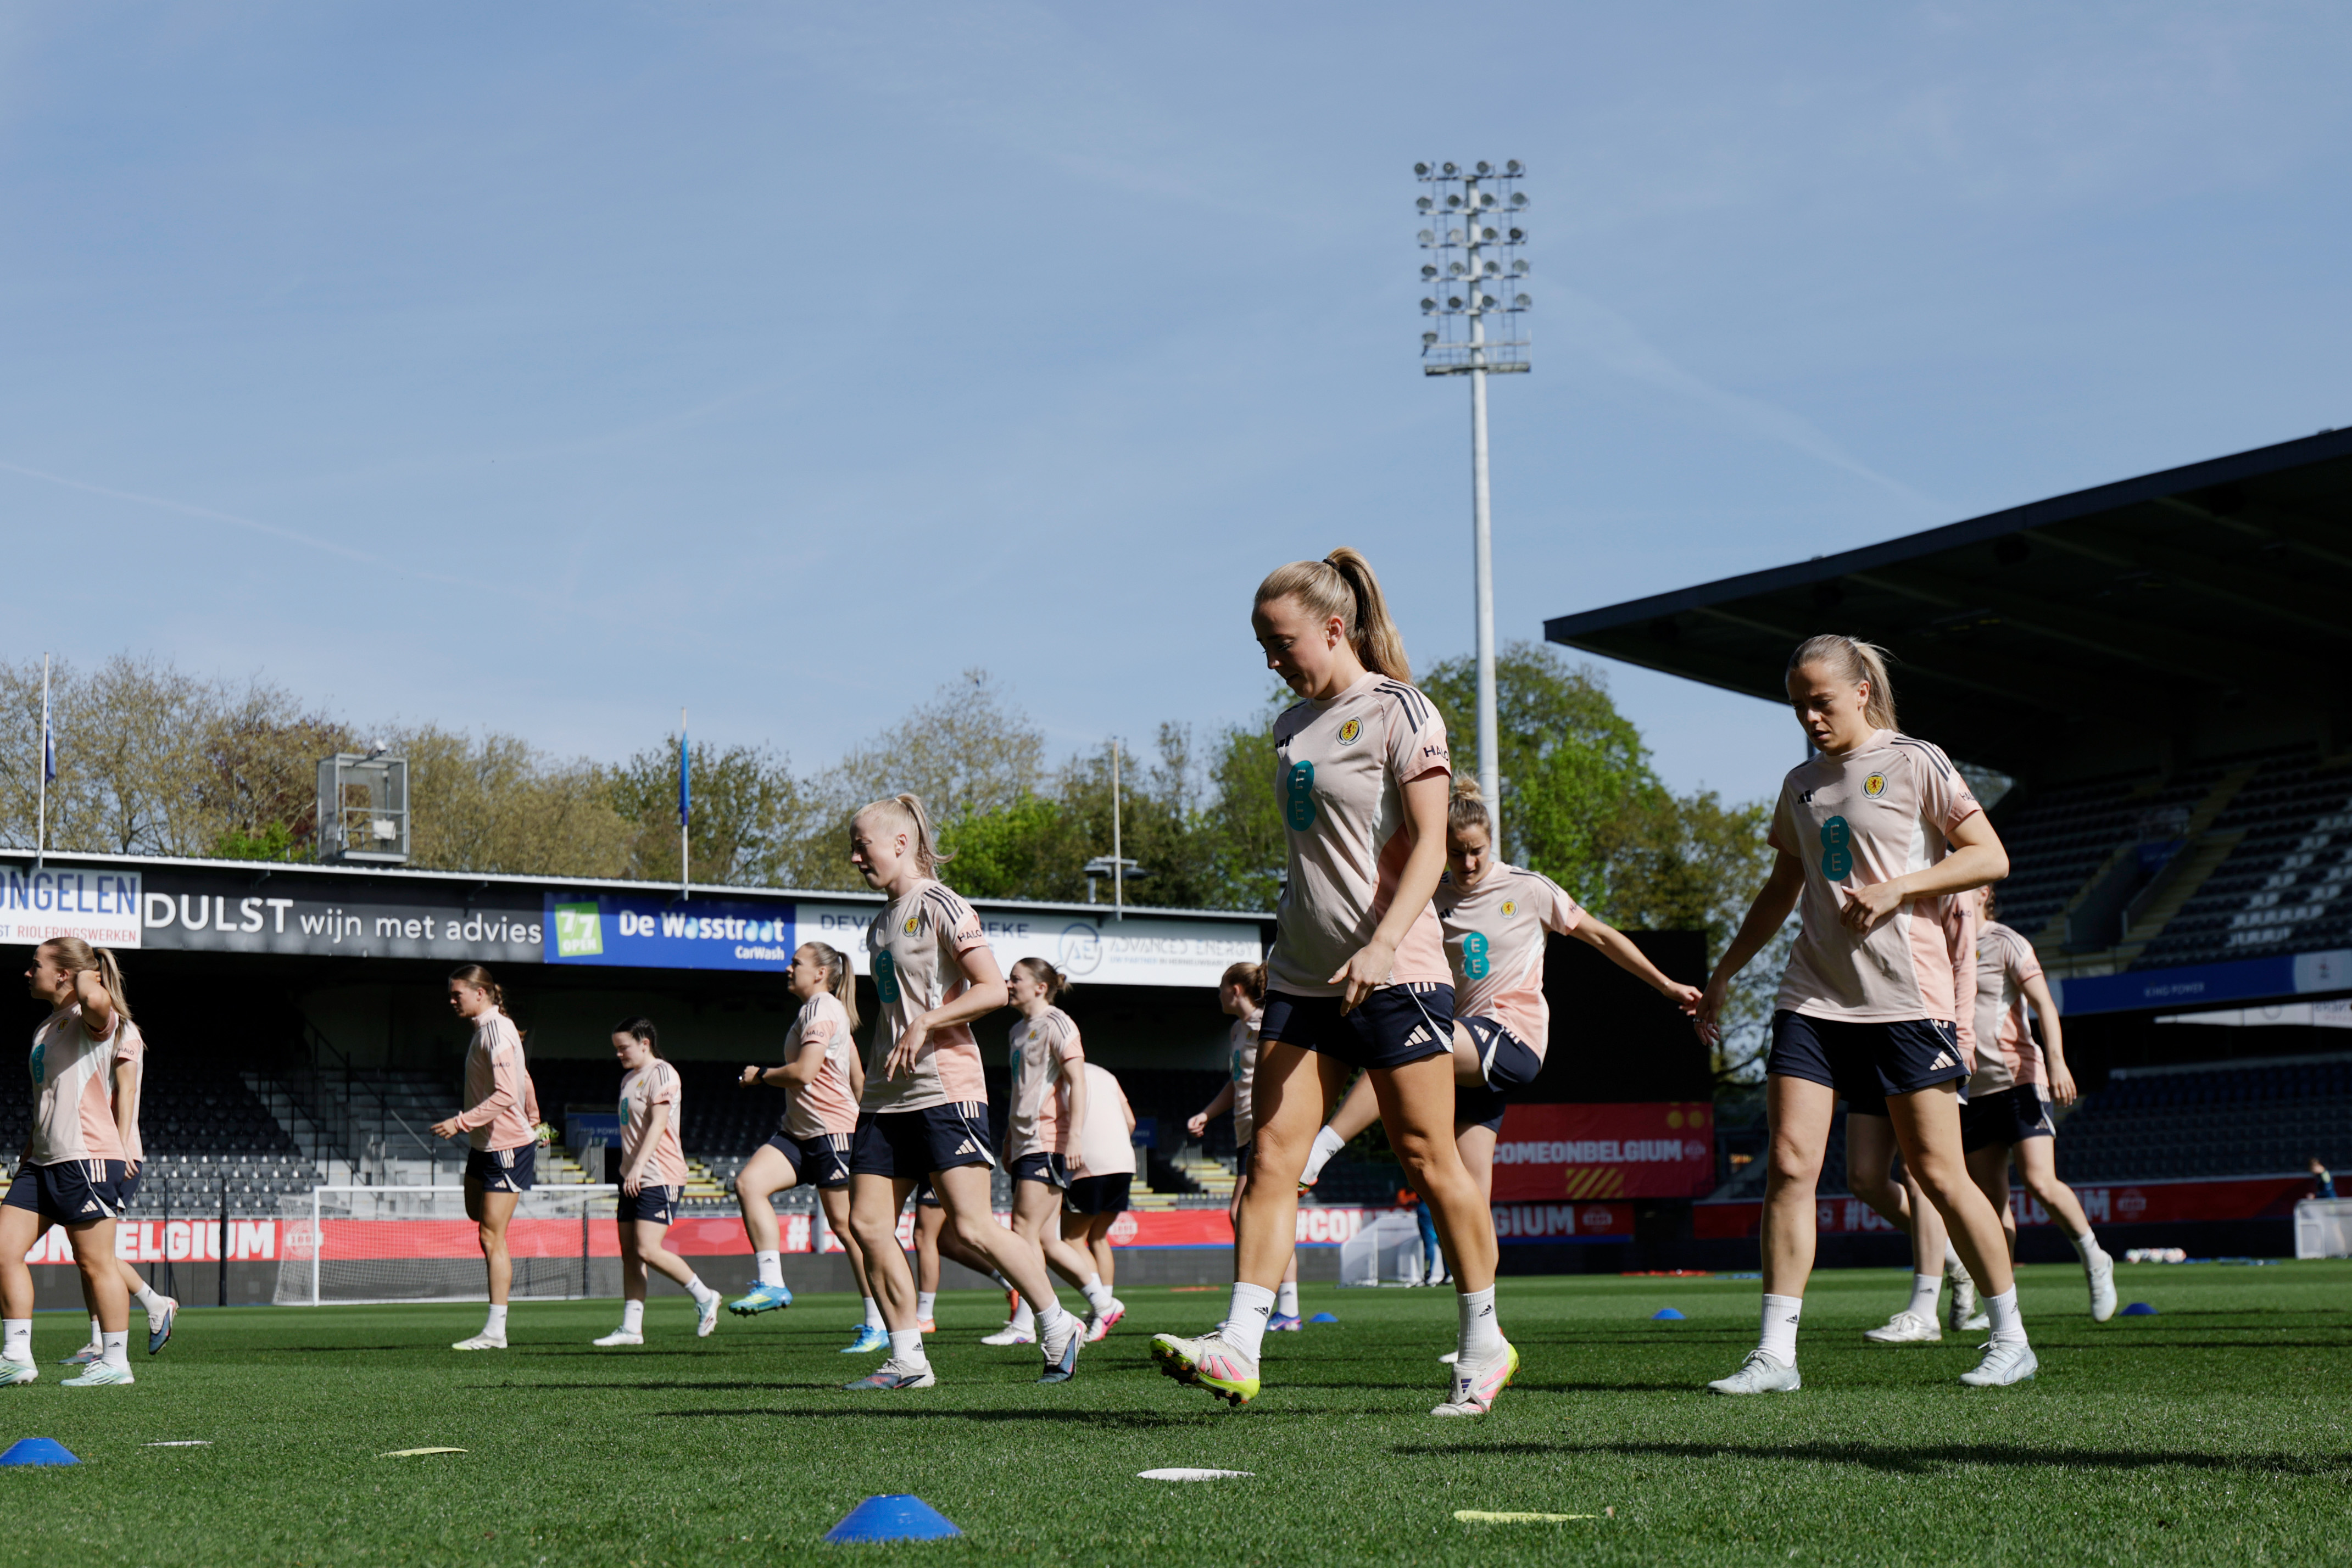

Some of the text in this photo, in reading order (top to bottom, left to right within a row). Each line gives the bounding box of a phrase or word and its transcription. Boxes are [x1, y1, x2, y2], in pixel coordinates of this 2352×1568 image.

[0, 869, 136, 916] NGELEN
[144, 892, 542, 944] DULST wijn met advies
[618, 909, 655, 937] De
[18, 925, 136, 942] RIOLERINGSWERKEN
[562, 938, 597, 952] OPEN
[957, 930, 982, 942] HALO
[734, 945, 785, 961] CarWash
[1196, 938, 1255, 957] ENERGY
[1471, 938, 1482, 973] EE
[882, 957, 893, 995] EE
